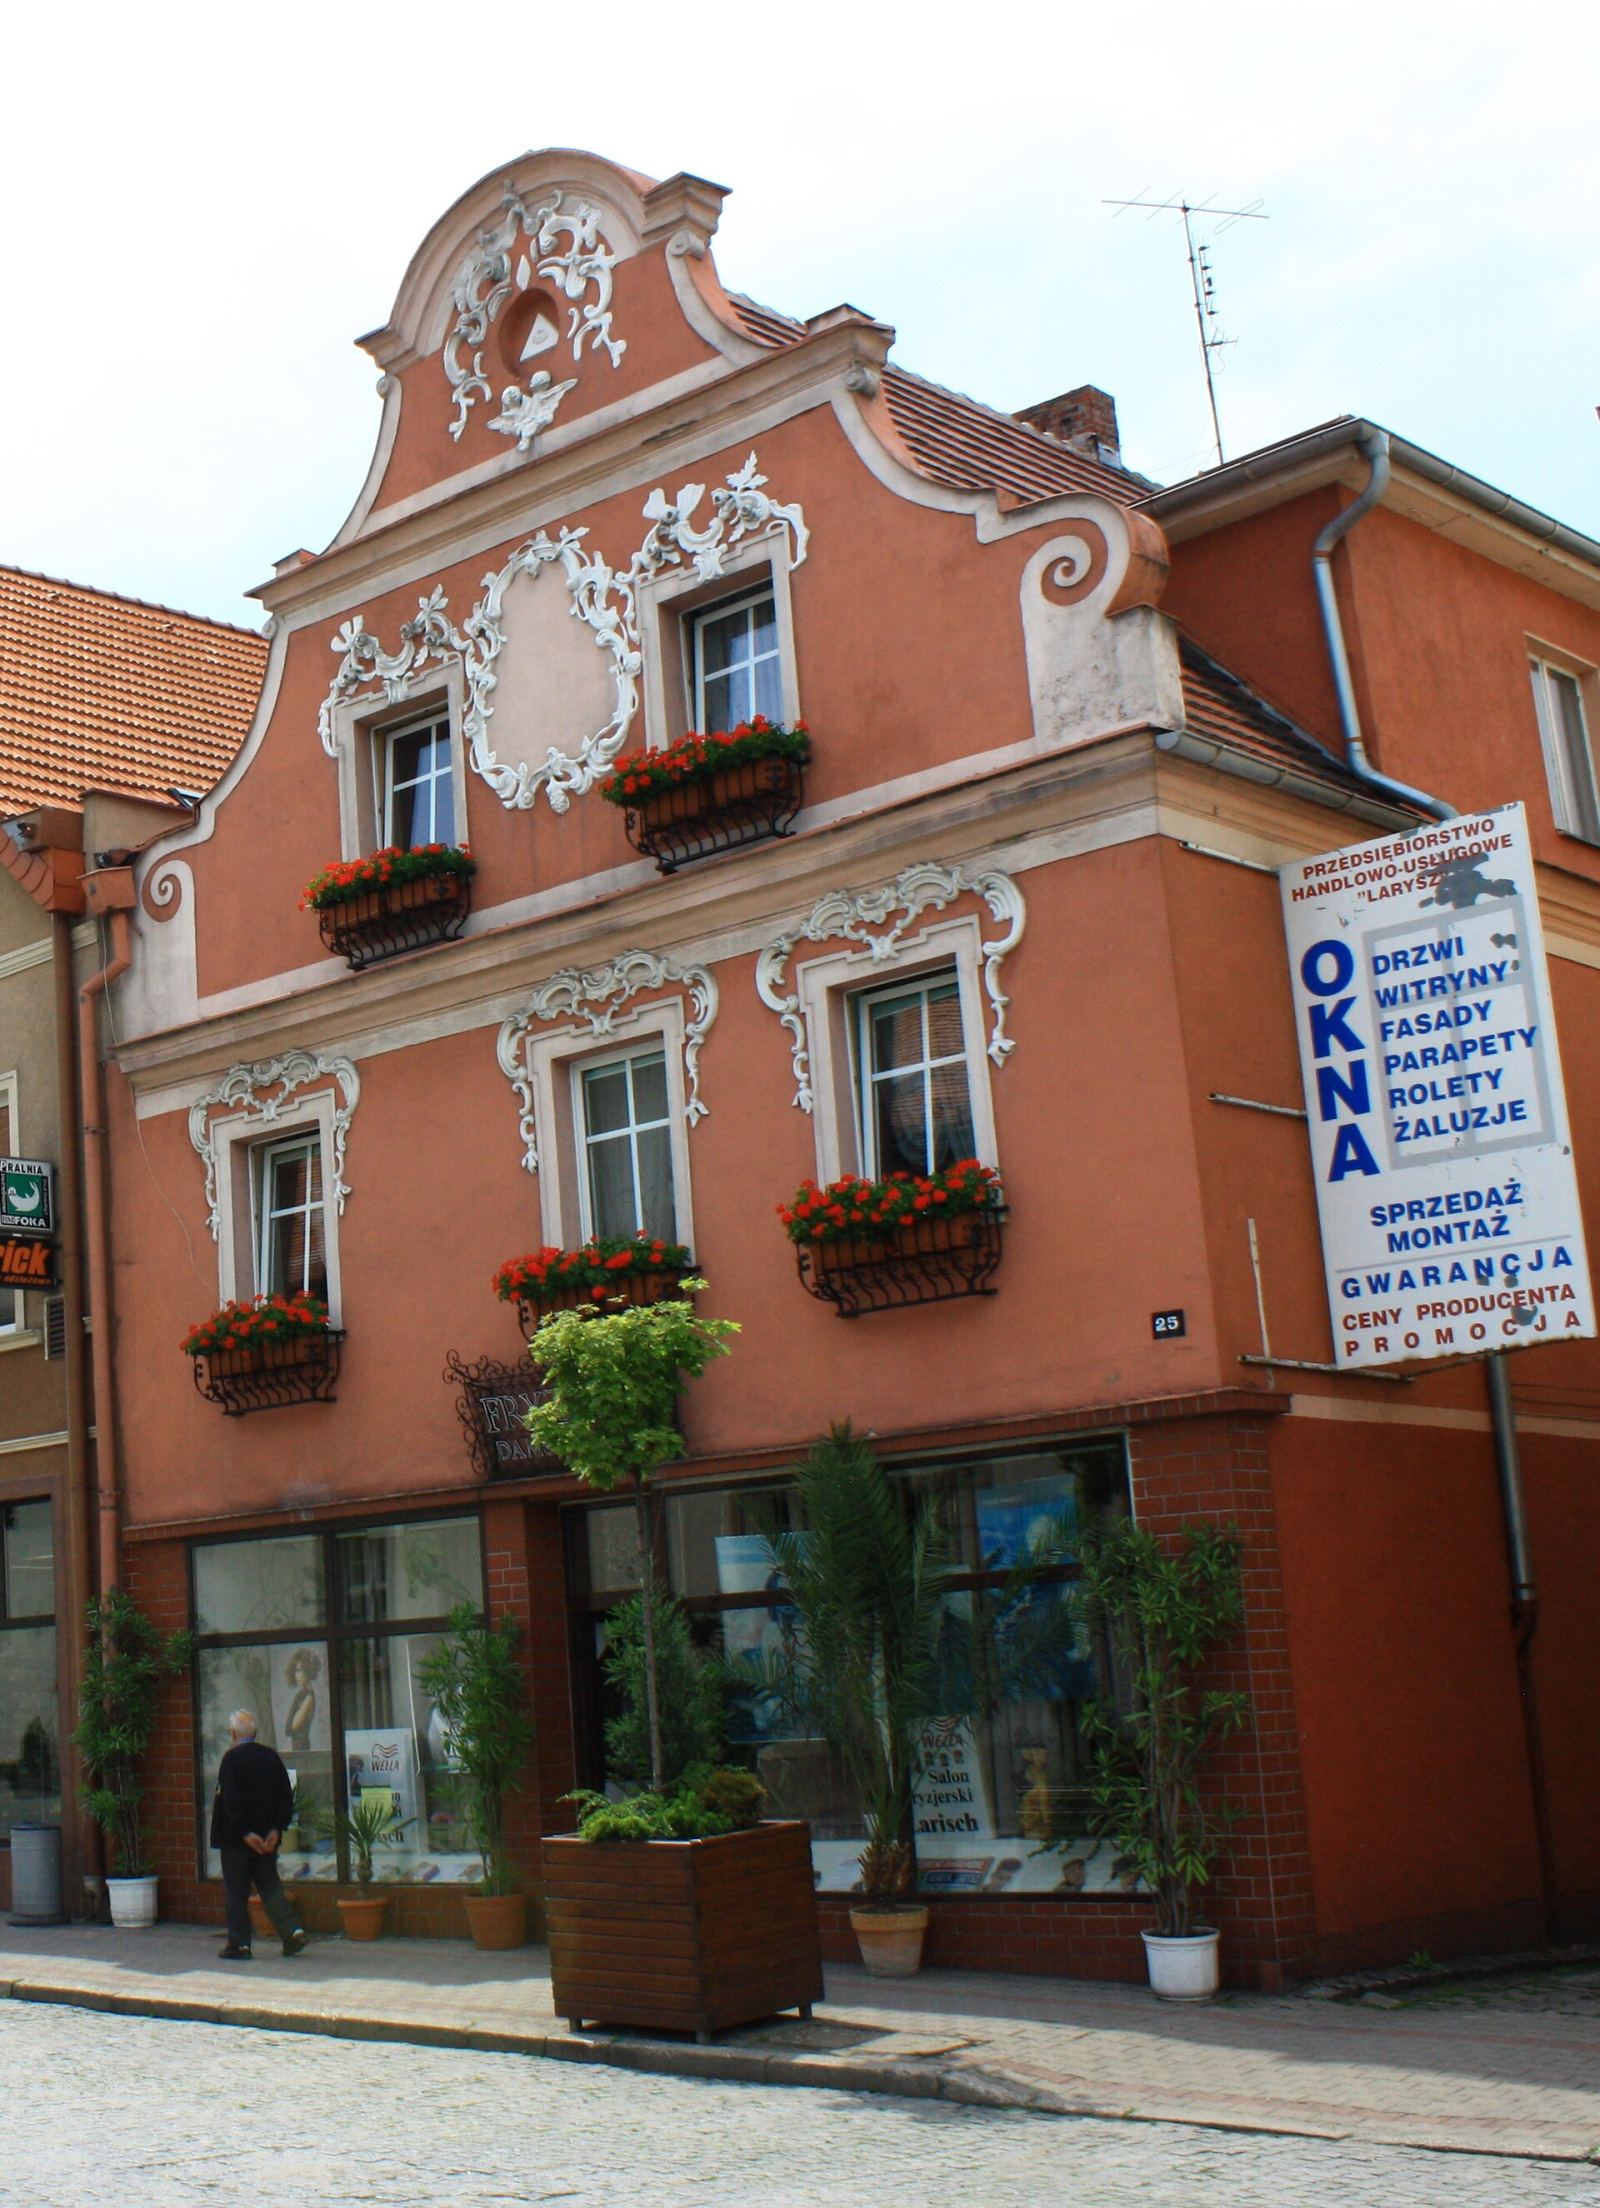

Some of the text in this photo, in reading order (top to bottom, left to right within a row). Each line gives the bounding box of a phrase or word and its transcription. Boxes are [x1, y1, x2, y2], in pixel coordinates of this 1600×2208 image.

[1291, 833, 1513, 902] HANDLOWO-USŁUGOWE
[1302, 818, 1495, 880] PRZEDSIĘBIORSTWO
[1372, 936, 1465, 976] DRZWI
[1374, 960, 1508, 1009] WITRYNY
[1380, 1000, 1492, 1043] FASADY
[1301, 939, 1381, 1183] OKNA
[1384, 1026, 1537, 1076] PARAPETY
[1388, 1068, 1503, 1110] ROLETY
[1393, 1099, 1528, 1143] ŻALUZJE
[1, 1160, 43, 1174] PRALNIA
[15, 1216, 46, 1227] FOKA
[1370, 1177, 1524, 1227] SPRZEDAŻ
[1387, 1209, 1510, 1253] MONTAŻ
[1341, 1246, 1573, 1299] GWARANCJA
[1155, 1316, 1178, 1331] 25
[1342, 1284, 1576, 1331] CENY PRODUCENTA
[1345, 1311, 1581, 1357] PROMOCJA
[371, 1760, 400, 1771] WELLA
[928, 1768, 970, 1785] Salon
[912, 1788, 973, 1808] ryzjerski
[914, 1812, 980, 1833] arisch
